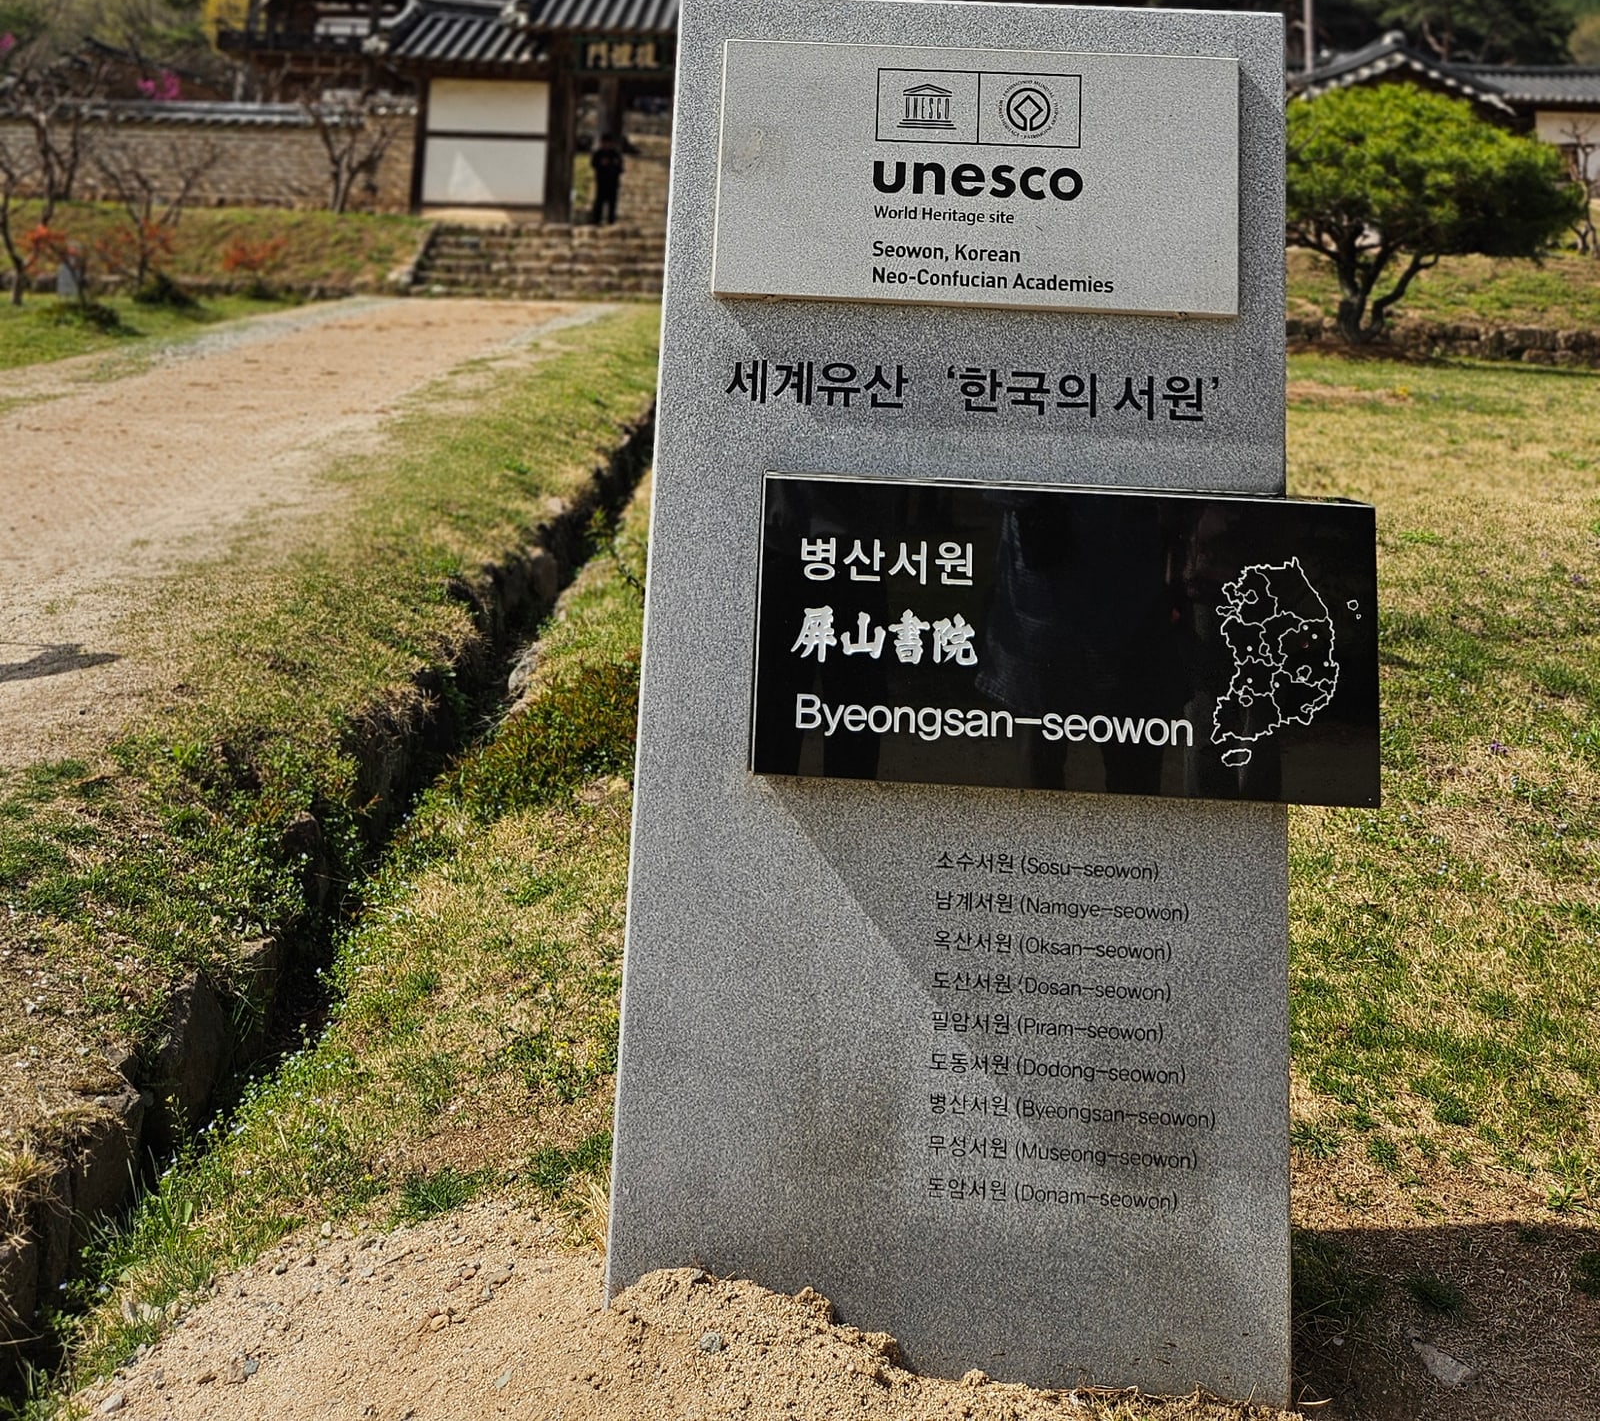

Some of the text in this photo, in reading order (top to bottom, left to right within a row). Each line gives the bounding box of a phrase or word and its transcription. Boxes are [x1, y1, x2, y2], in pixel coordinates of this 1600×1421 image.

[905, 96, 950, 120] UNESCO
[873, 160, 1084, 201] unesco
[874, 205, 1015, 226] World Heritage site
[872, 240, 1021, 263] Seowon, Korean
[872, 267, 1115, 294] Neo-Confucian Academies
[725, 359, 909, 409] 세계유산
[800, 536, 975, 586] 병산서원
[794, 692, 1195, 749] Byeongsan-seowon
[935, 851, 1014, 875] 소수서원
[935, 890, 1014, 914] 남계서원
[933, 929, 1012, 954] 옥산서원
[931, 971, 1012, 994] 도산서원
[931, 1011, 1010, 1035] 필암서원
[929, 1052, 1010, 1076] 도동서원
[929, 1092, 1009, 1117] 병산서원
[927, 1135, 1008, 1160] 무성서원
[927, 1177, 1008, 1202] 돈암서원
